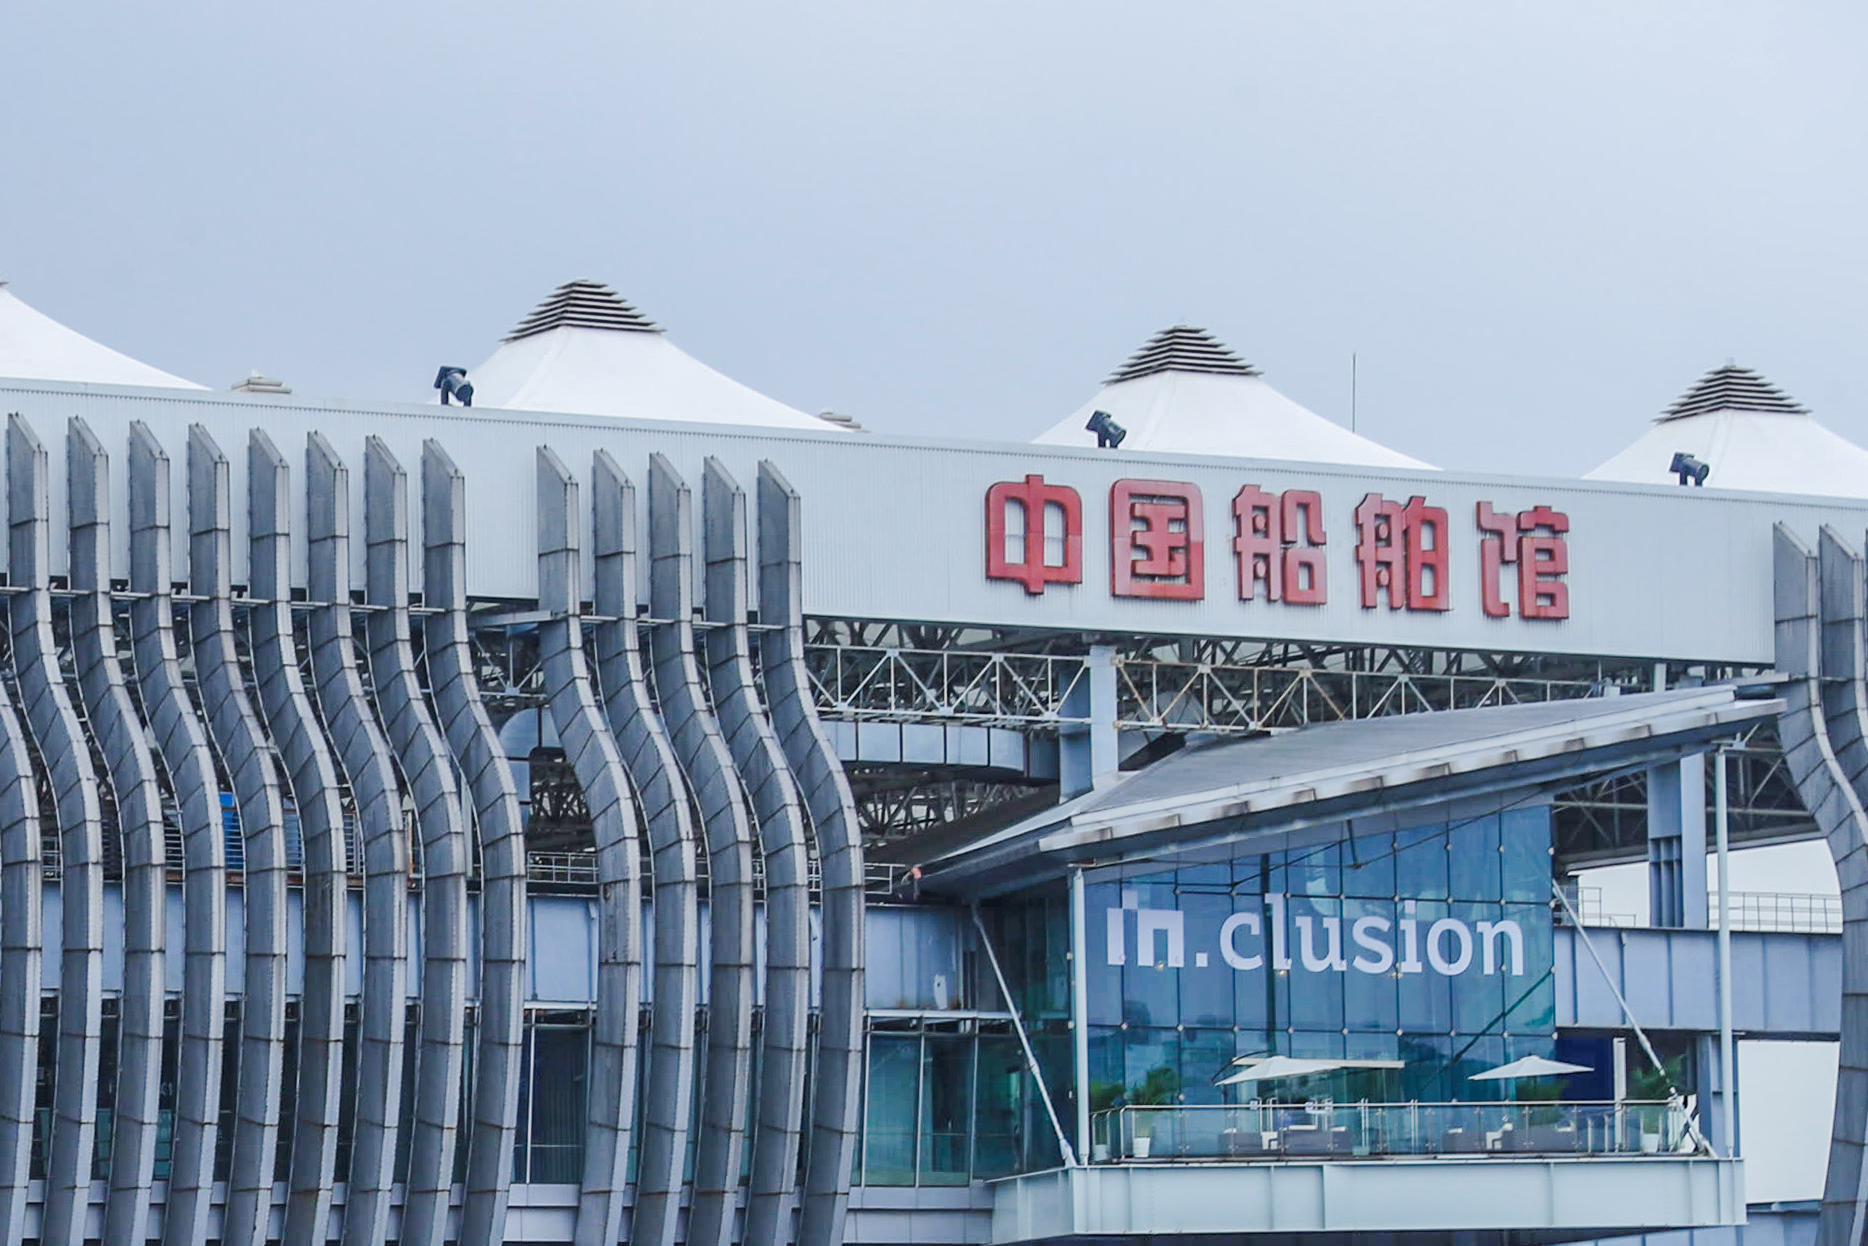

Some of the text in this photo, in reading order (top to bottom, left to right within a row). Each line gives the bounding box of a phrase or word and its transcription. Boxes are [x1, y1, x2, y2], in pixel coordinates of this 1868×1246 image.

[985, 474, 1569, 619] 中国船舶馆
[1106, 892, 1525, 976] in.clusion
